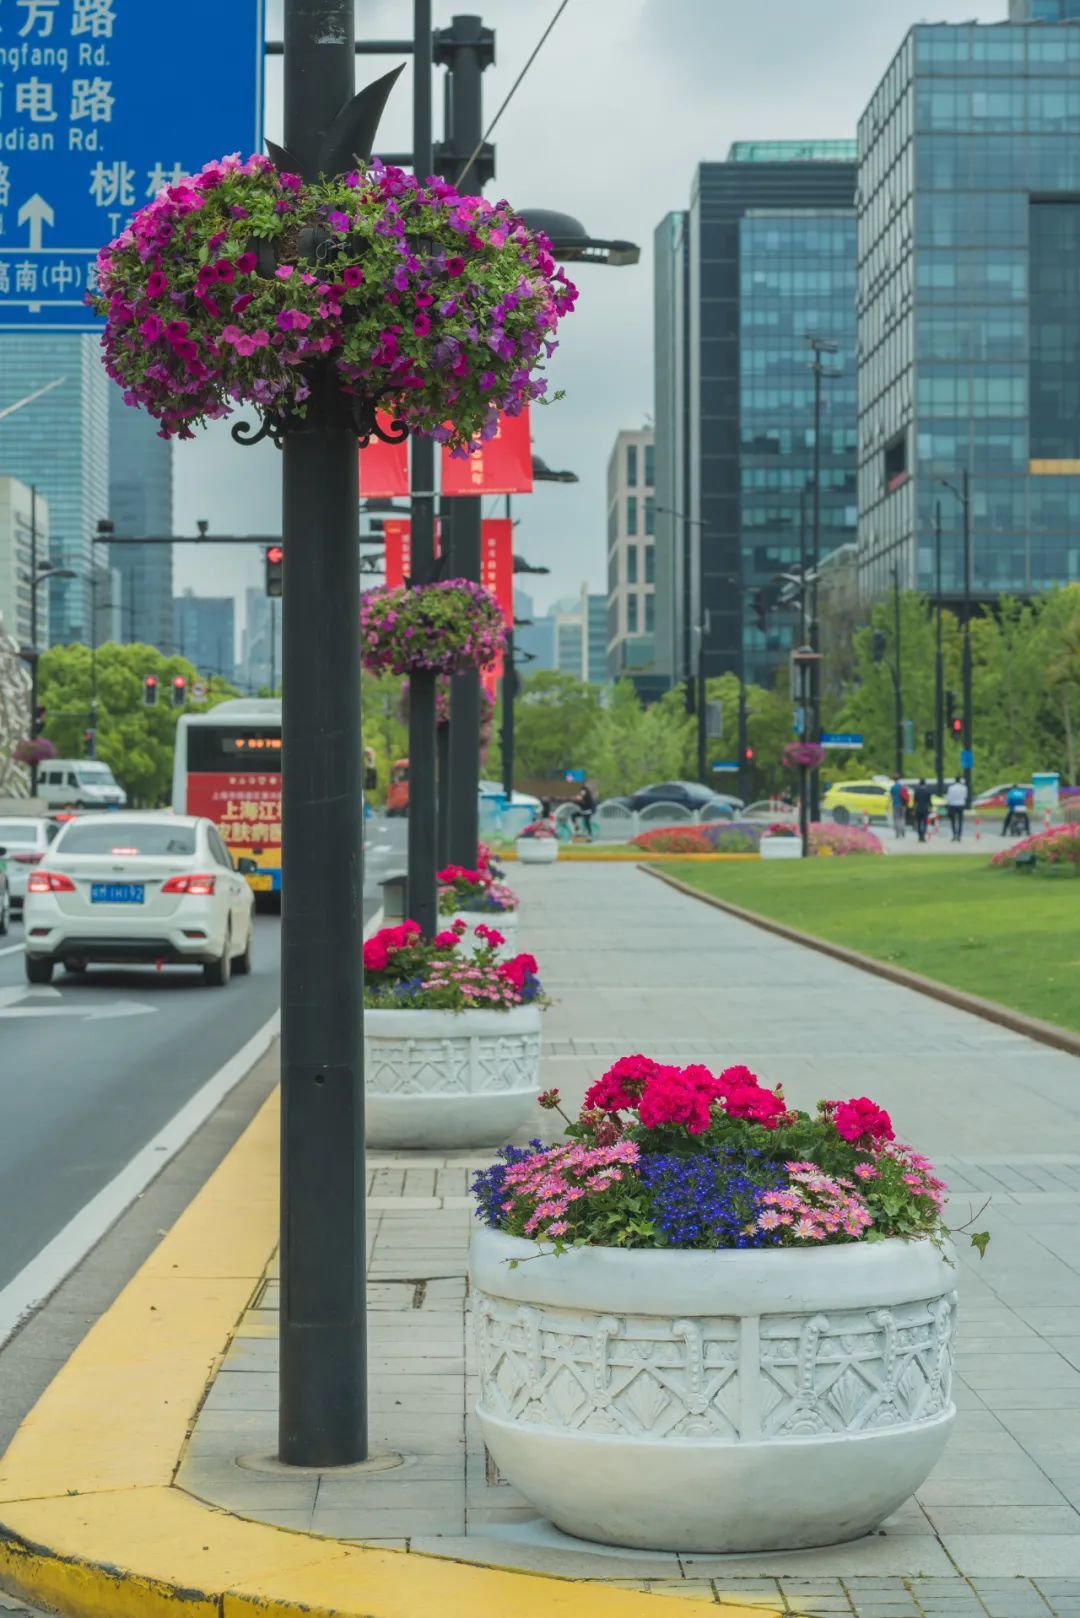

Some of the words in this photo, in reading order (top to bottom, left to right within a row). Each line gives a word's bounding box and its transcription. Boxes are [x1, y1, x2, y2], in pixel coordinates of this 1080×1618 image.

[0, 0, 117, 38] 方路
[79, 42, 111, 66] Rd.
[0, 76, 116, 122] 电路
[0, 127, 54, 151] dian
[68, 127, 104, 151] Rd.
[220, 800, 281, 821] 上海江
